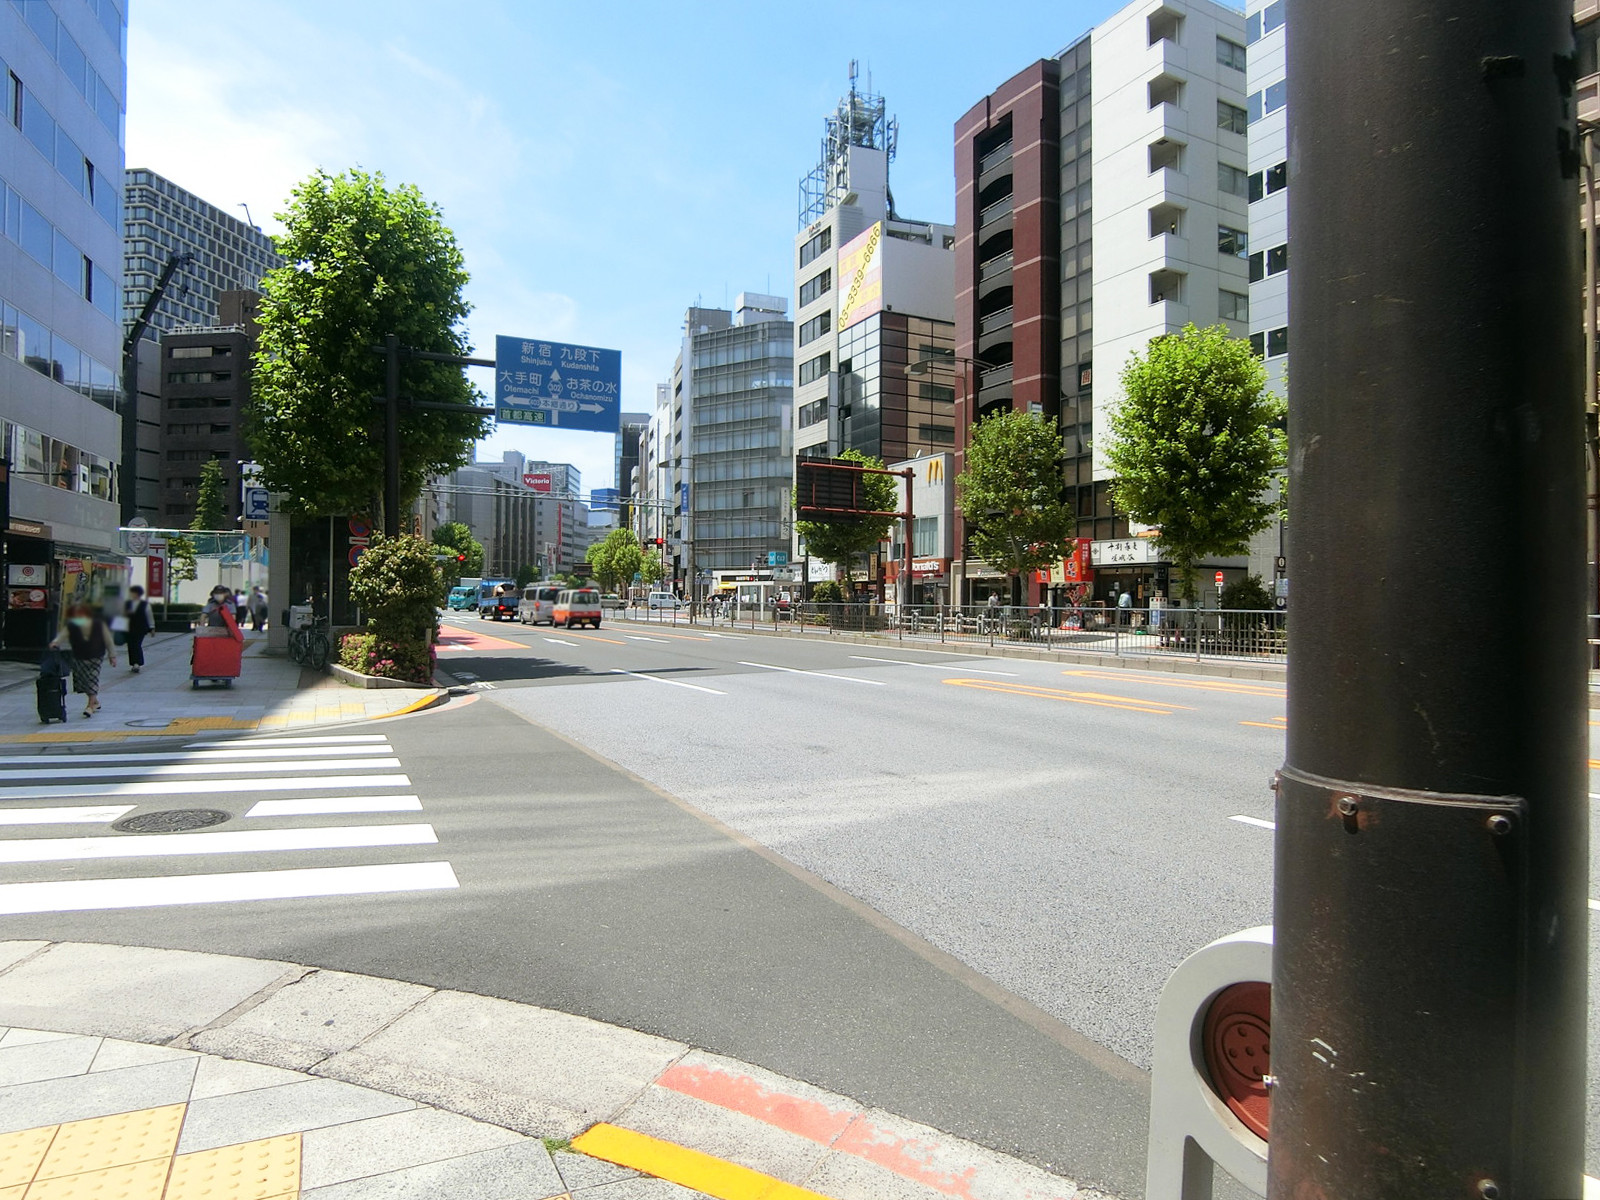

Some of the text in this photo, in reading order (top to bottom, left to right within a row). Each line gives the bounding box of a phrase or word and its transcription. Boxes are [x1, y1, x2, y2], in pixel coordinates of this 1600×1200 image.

[521, 341, 600, 362] 新宿 九段下
[521, 355, 599, 372] Shinjuku Kudanshita
[500, 370, 542, 386] 大手町
[504, 384, 539, 394] Otemachi
[549, 383, 561, 392] 302
[566, 378, 617, 394] お茶の水
[570, 391, 613, 402] Ochanomizu
[502, 409, 544, 422] 首都高速
